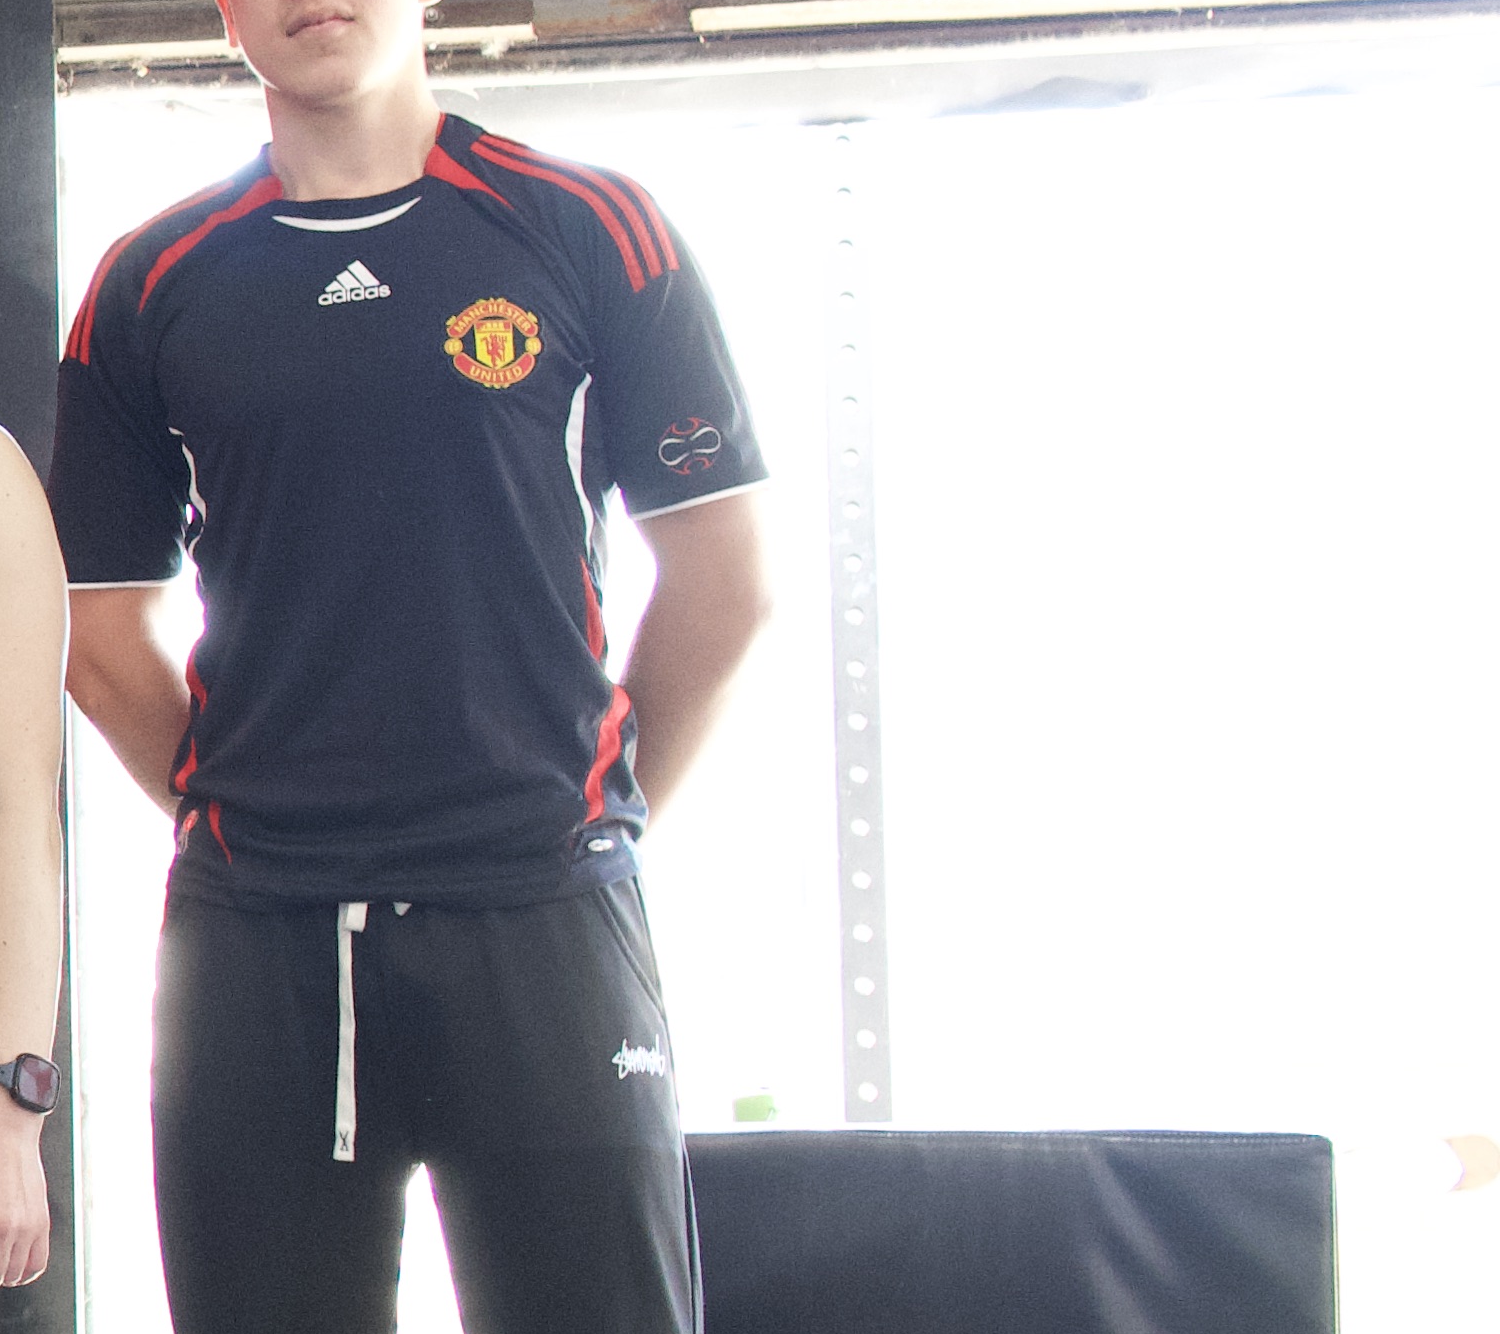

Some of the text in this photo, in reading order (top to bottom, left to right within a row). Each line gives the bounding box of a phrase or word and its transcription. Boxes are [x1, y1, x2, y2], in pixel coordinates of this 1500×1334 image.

[317, 284, 392, 307] adidas
[453, 303, 533, 334] MANCHESTER
[468, 365, 523, 382] UNITED
